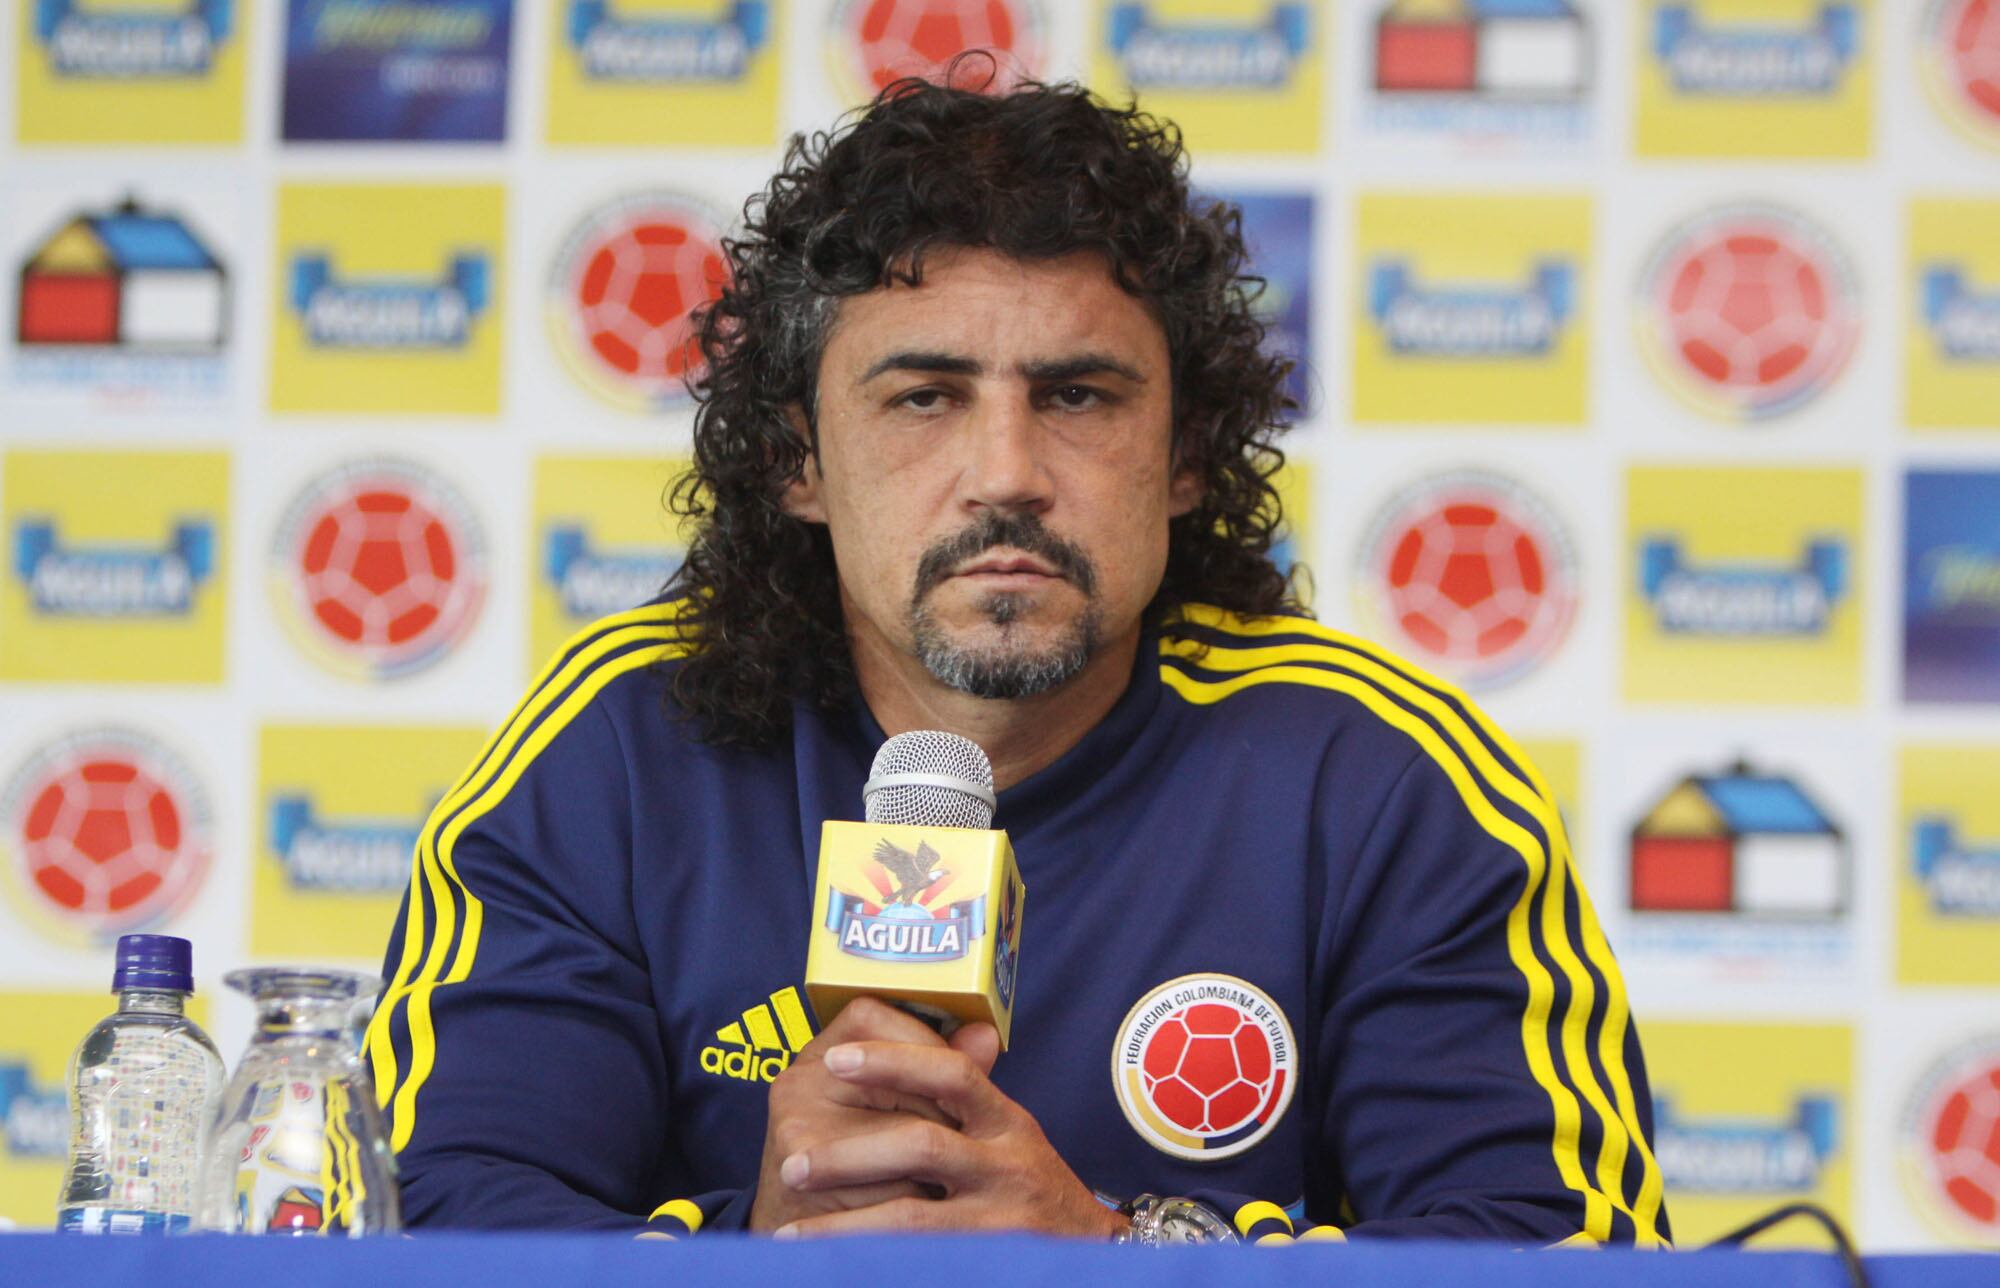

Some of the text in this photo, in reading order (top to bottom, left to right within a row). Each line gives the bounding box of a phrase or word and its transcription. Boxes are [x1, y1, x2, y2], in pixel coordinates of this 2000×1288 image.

[844, 918, 961, 955] AGUILA
[1126, 986, 1287, 1065] FEDERACION COLOMBIANA DE FUTBOL
[700, 1043, 791, 1083] adid
